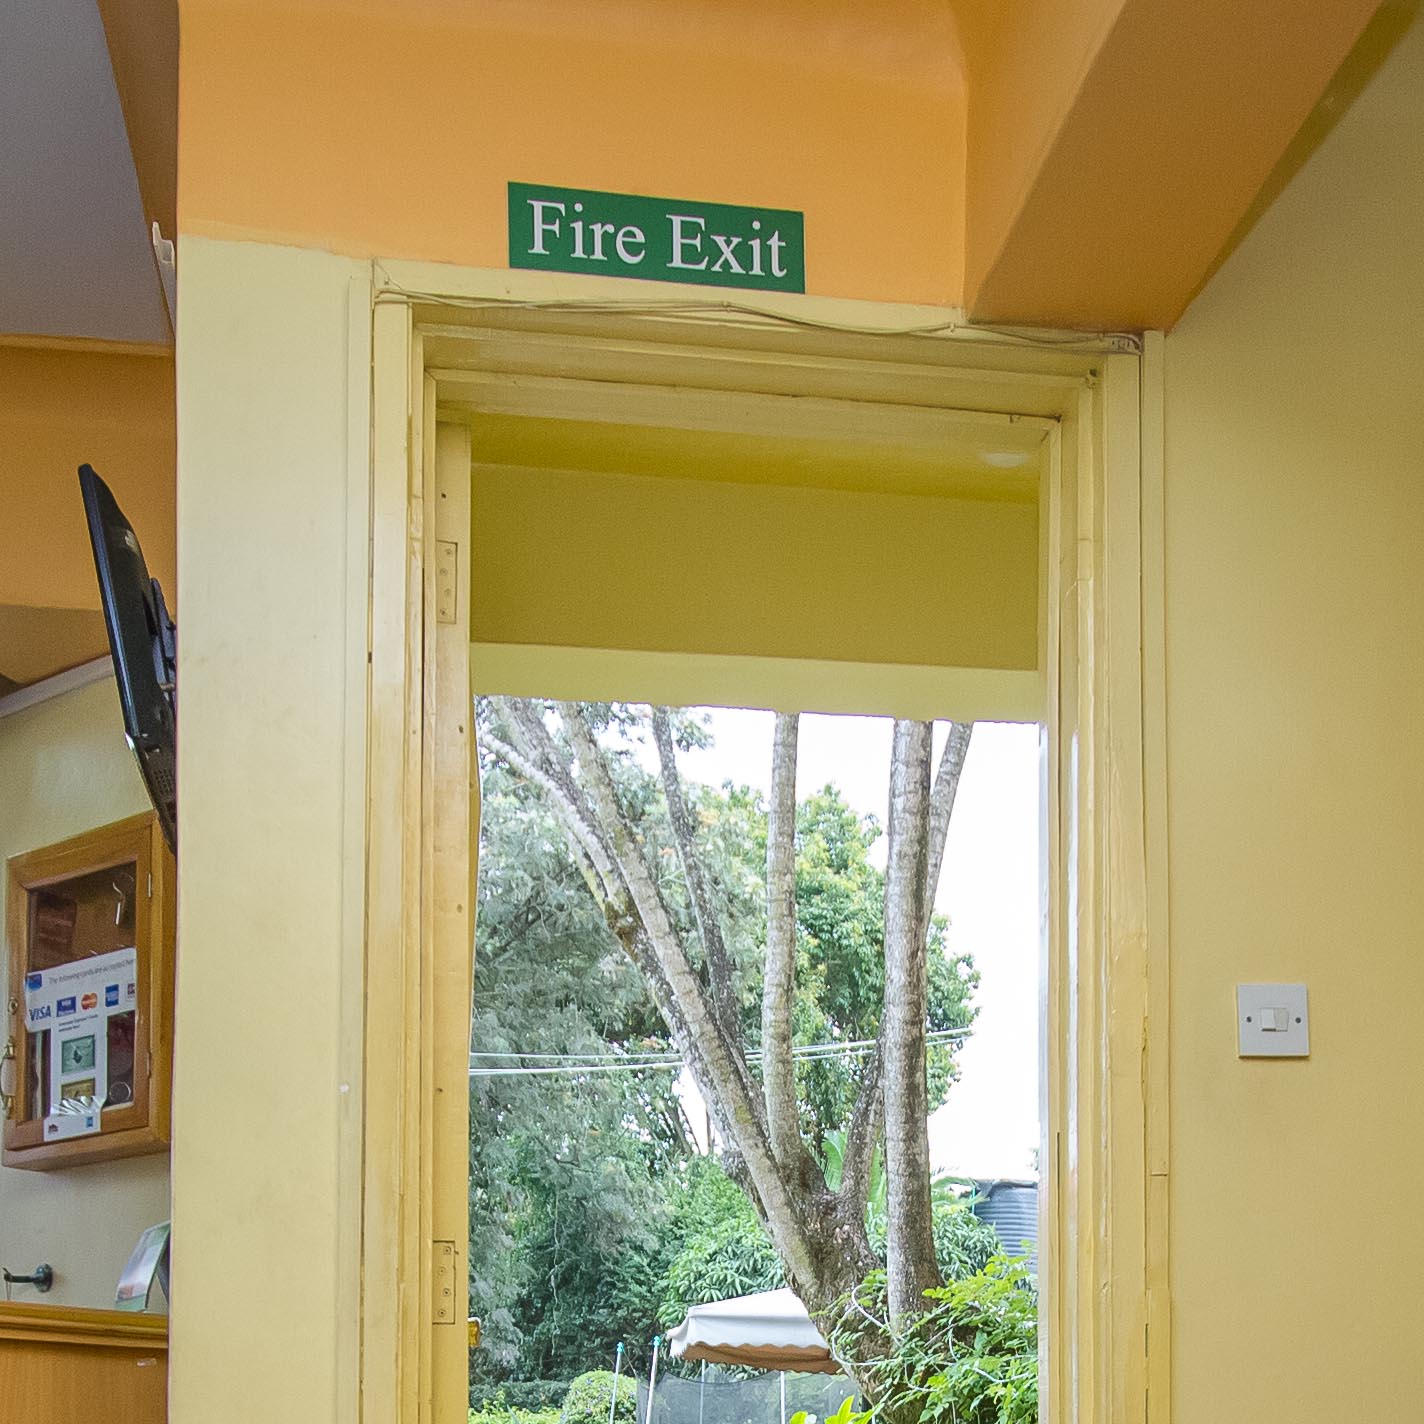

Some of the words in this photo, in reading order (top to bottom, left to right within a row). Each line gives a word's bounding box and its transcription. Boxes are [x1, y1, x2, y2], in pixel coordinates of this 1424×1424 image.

[526, 199, 646, 265] Fire
[665, 213, 788, 278] Exit
[29, 1005, 51, 1021] VISA
